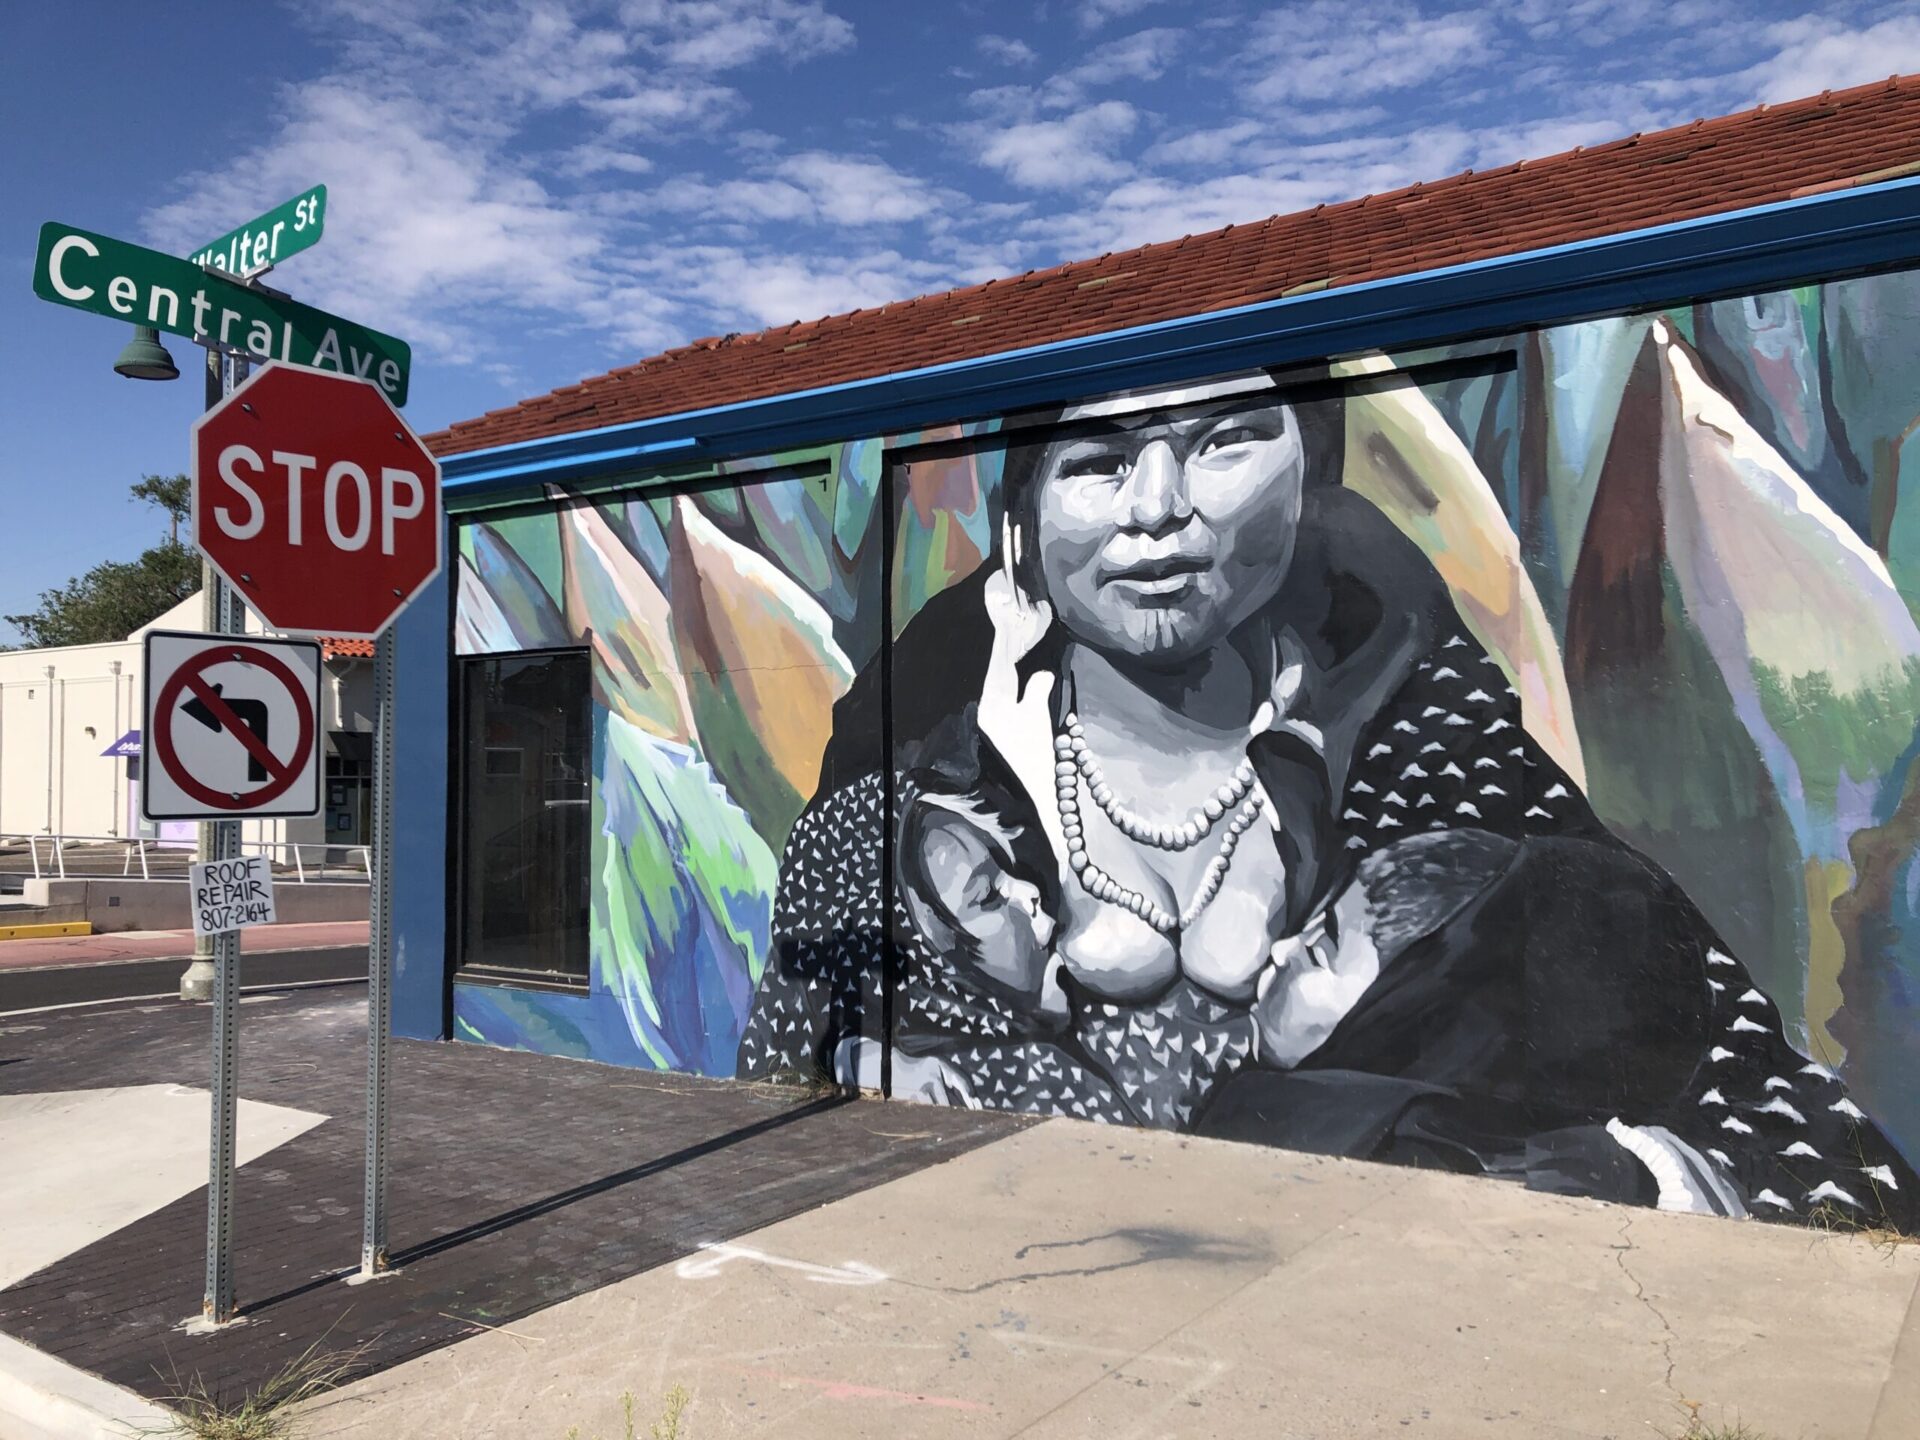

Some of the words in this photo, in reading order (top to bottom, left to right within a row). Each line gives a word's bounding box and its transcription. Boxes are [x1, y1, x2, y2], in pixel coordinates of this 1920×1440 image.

[294, 194, 318, 231] St
[48, 235, 292, 362] Central
[312, 328, 400, 392] Ave
[214, 444, 425, 556] STOP
[204, 858, 261, 885] ROOF
[197, 881, 269, 908] REPAIR
[201, 902, 271, 931] 807-2164
